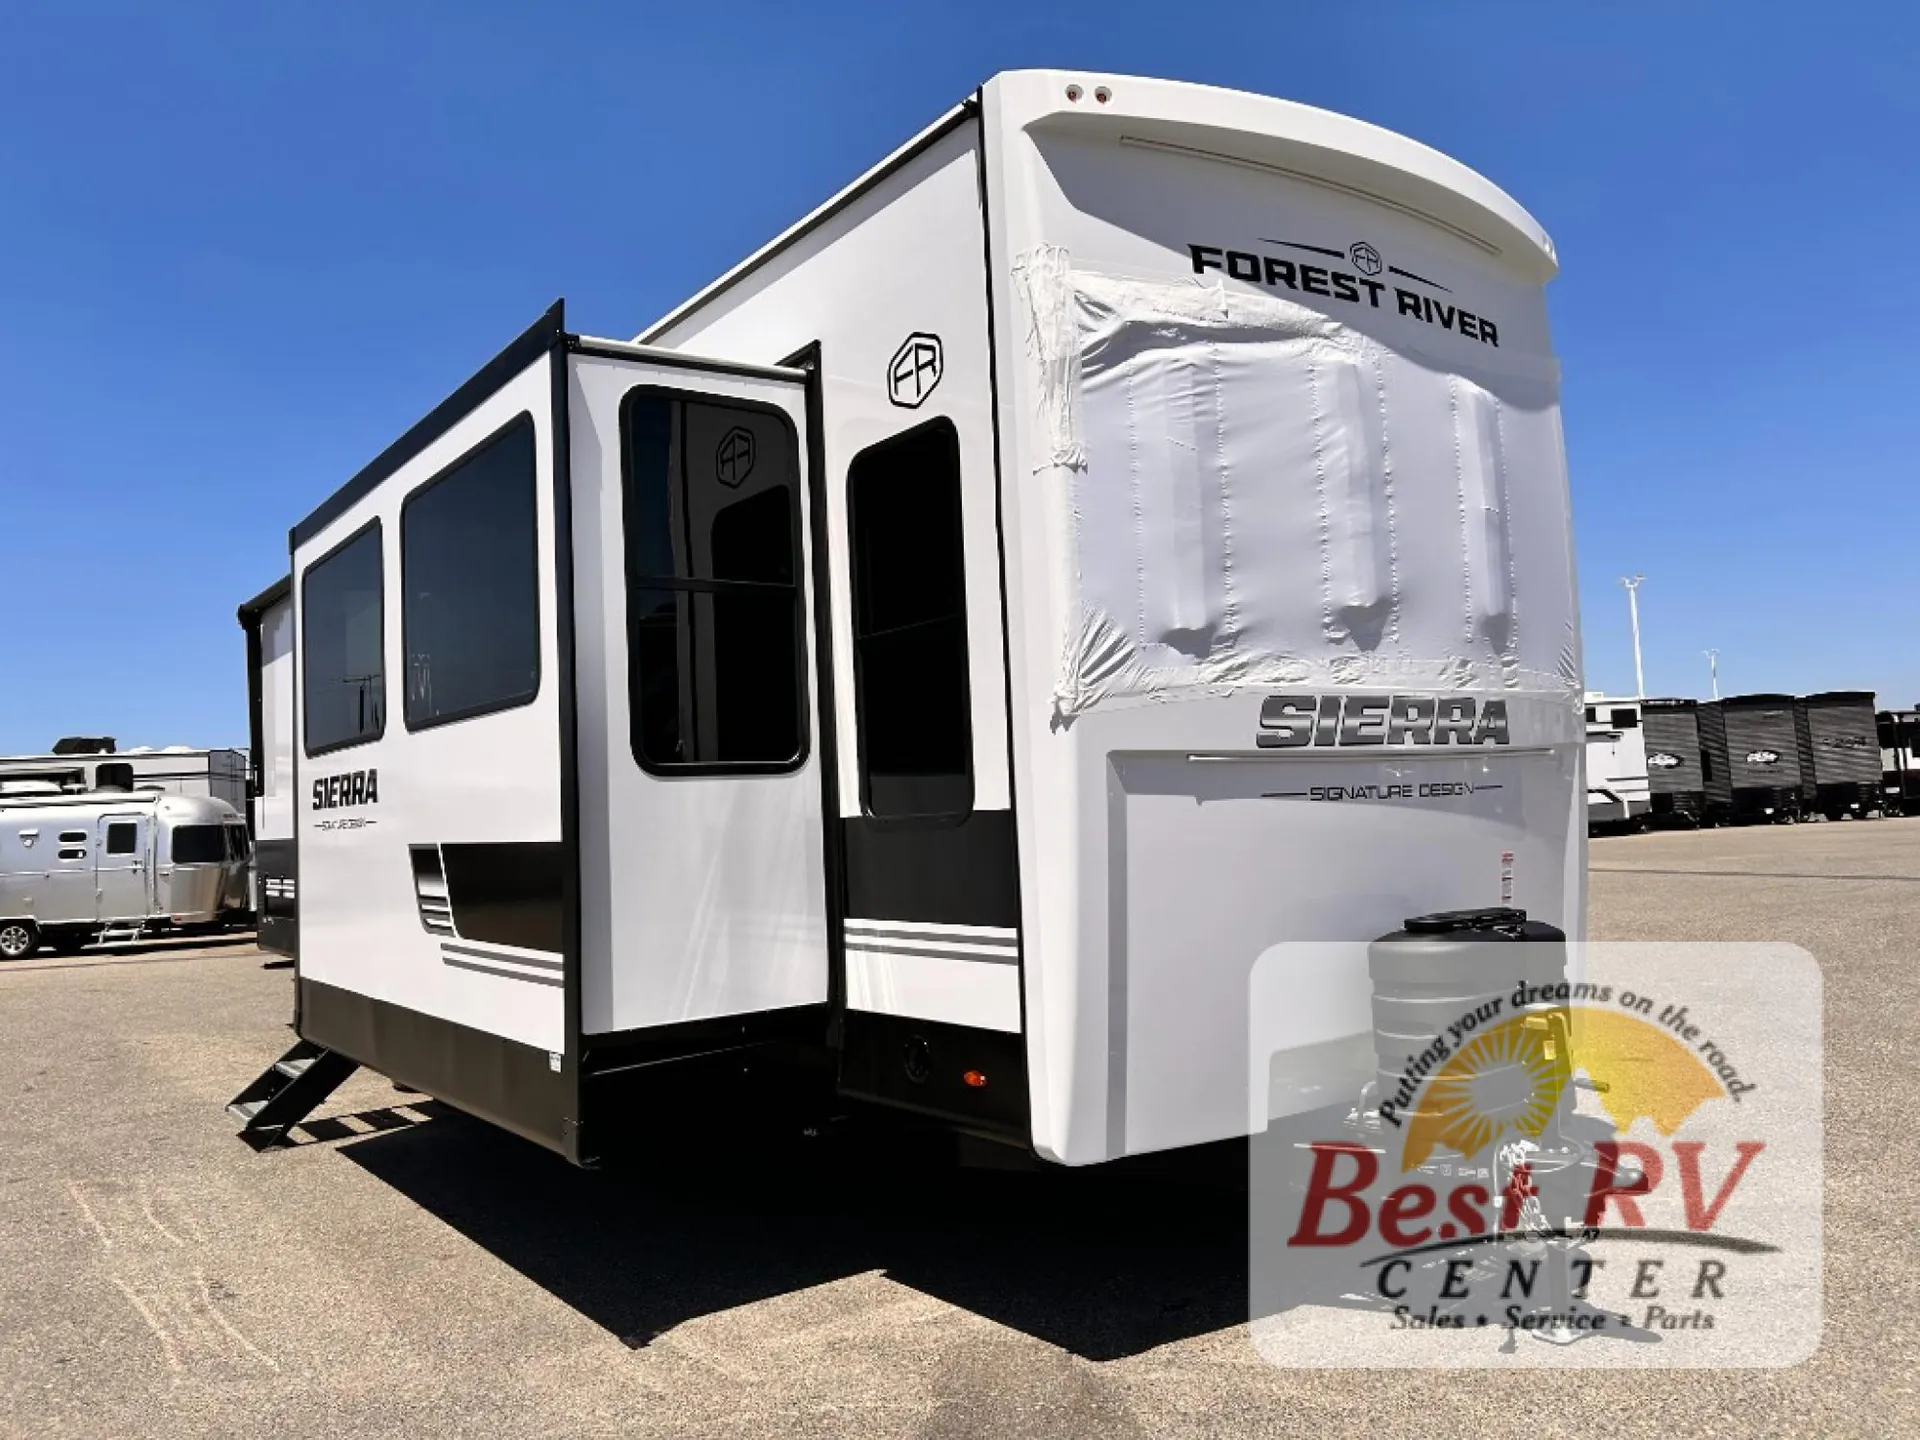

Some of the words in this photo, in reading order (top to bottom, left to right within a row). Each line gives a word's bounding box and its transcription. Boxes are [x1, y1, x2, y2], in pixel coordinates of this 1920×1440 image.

[1187, 244, 1386, 308] FOREST
[1393, 286, 1499, 347] RIVER
[1256, 695, 1510, 748] SIERRA
[312, 768, 378, 811] SIERRA
[1310, 784, 1413, 801] SIGNATURE
[1418, 782, 1475, 798] DESIGN
